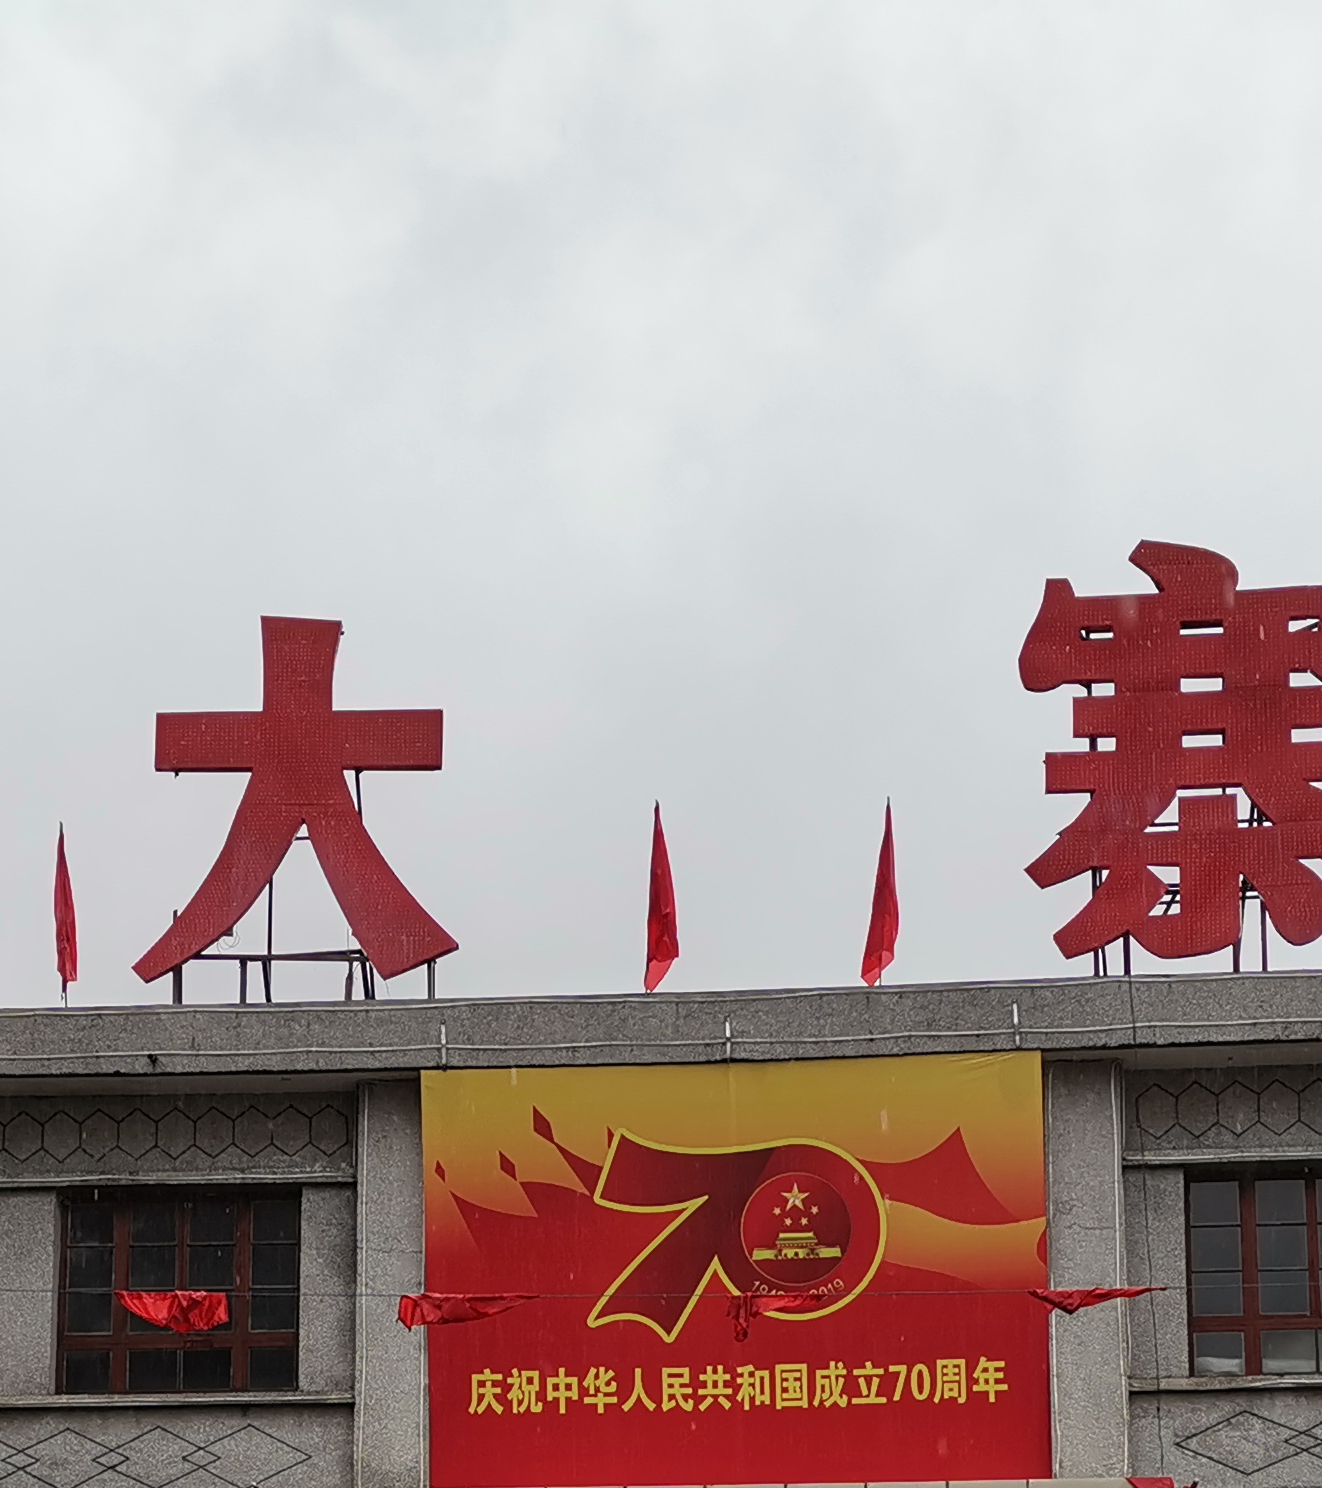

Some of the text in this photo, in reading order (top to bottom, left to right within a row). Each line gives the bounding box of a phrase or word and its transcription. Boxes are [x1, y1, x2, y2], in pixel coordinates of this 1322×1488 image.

[467, 1355, 1010, 1417] 庆祝中华人民共和国成立70周年
